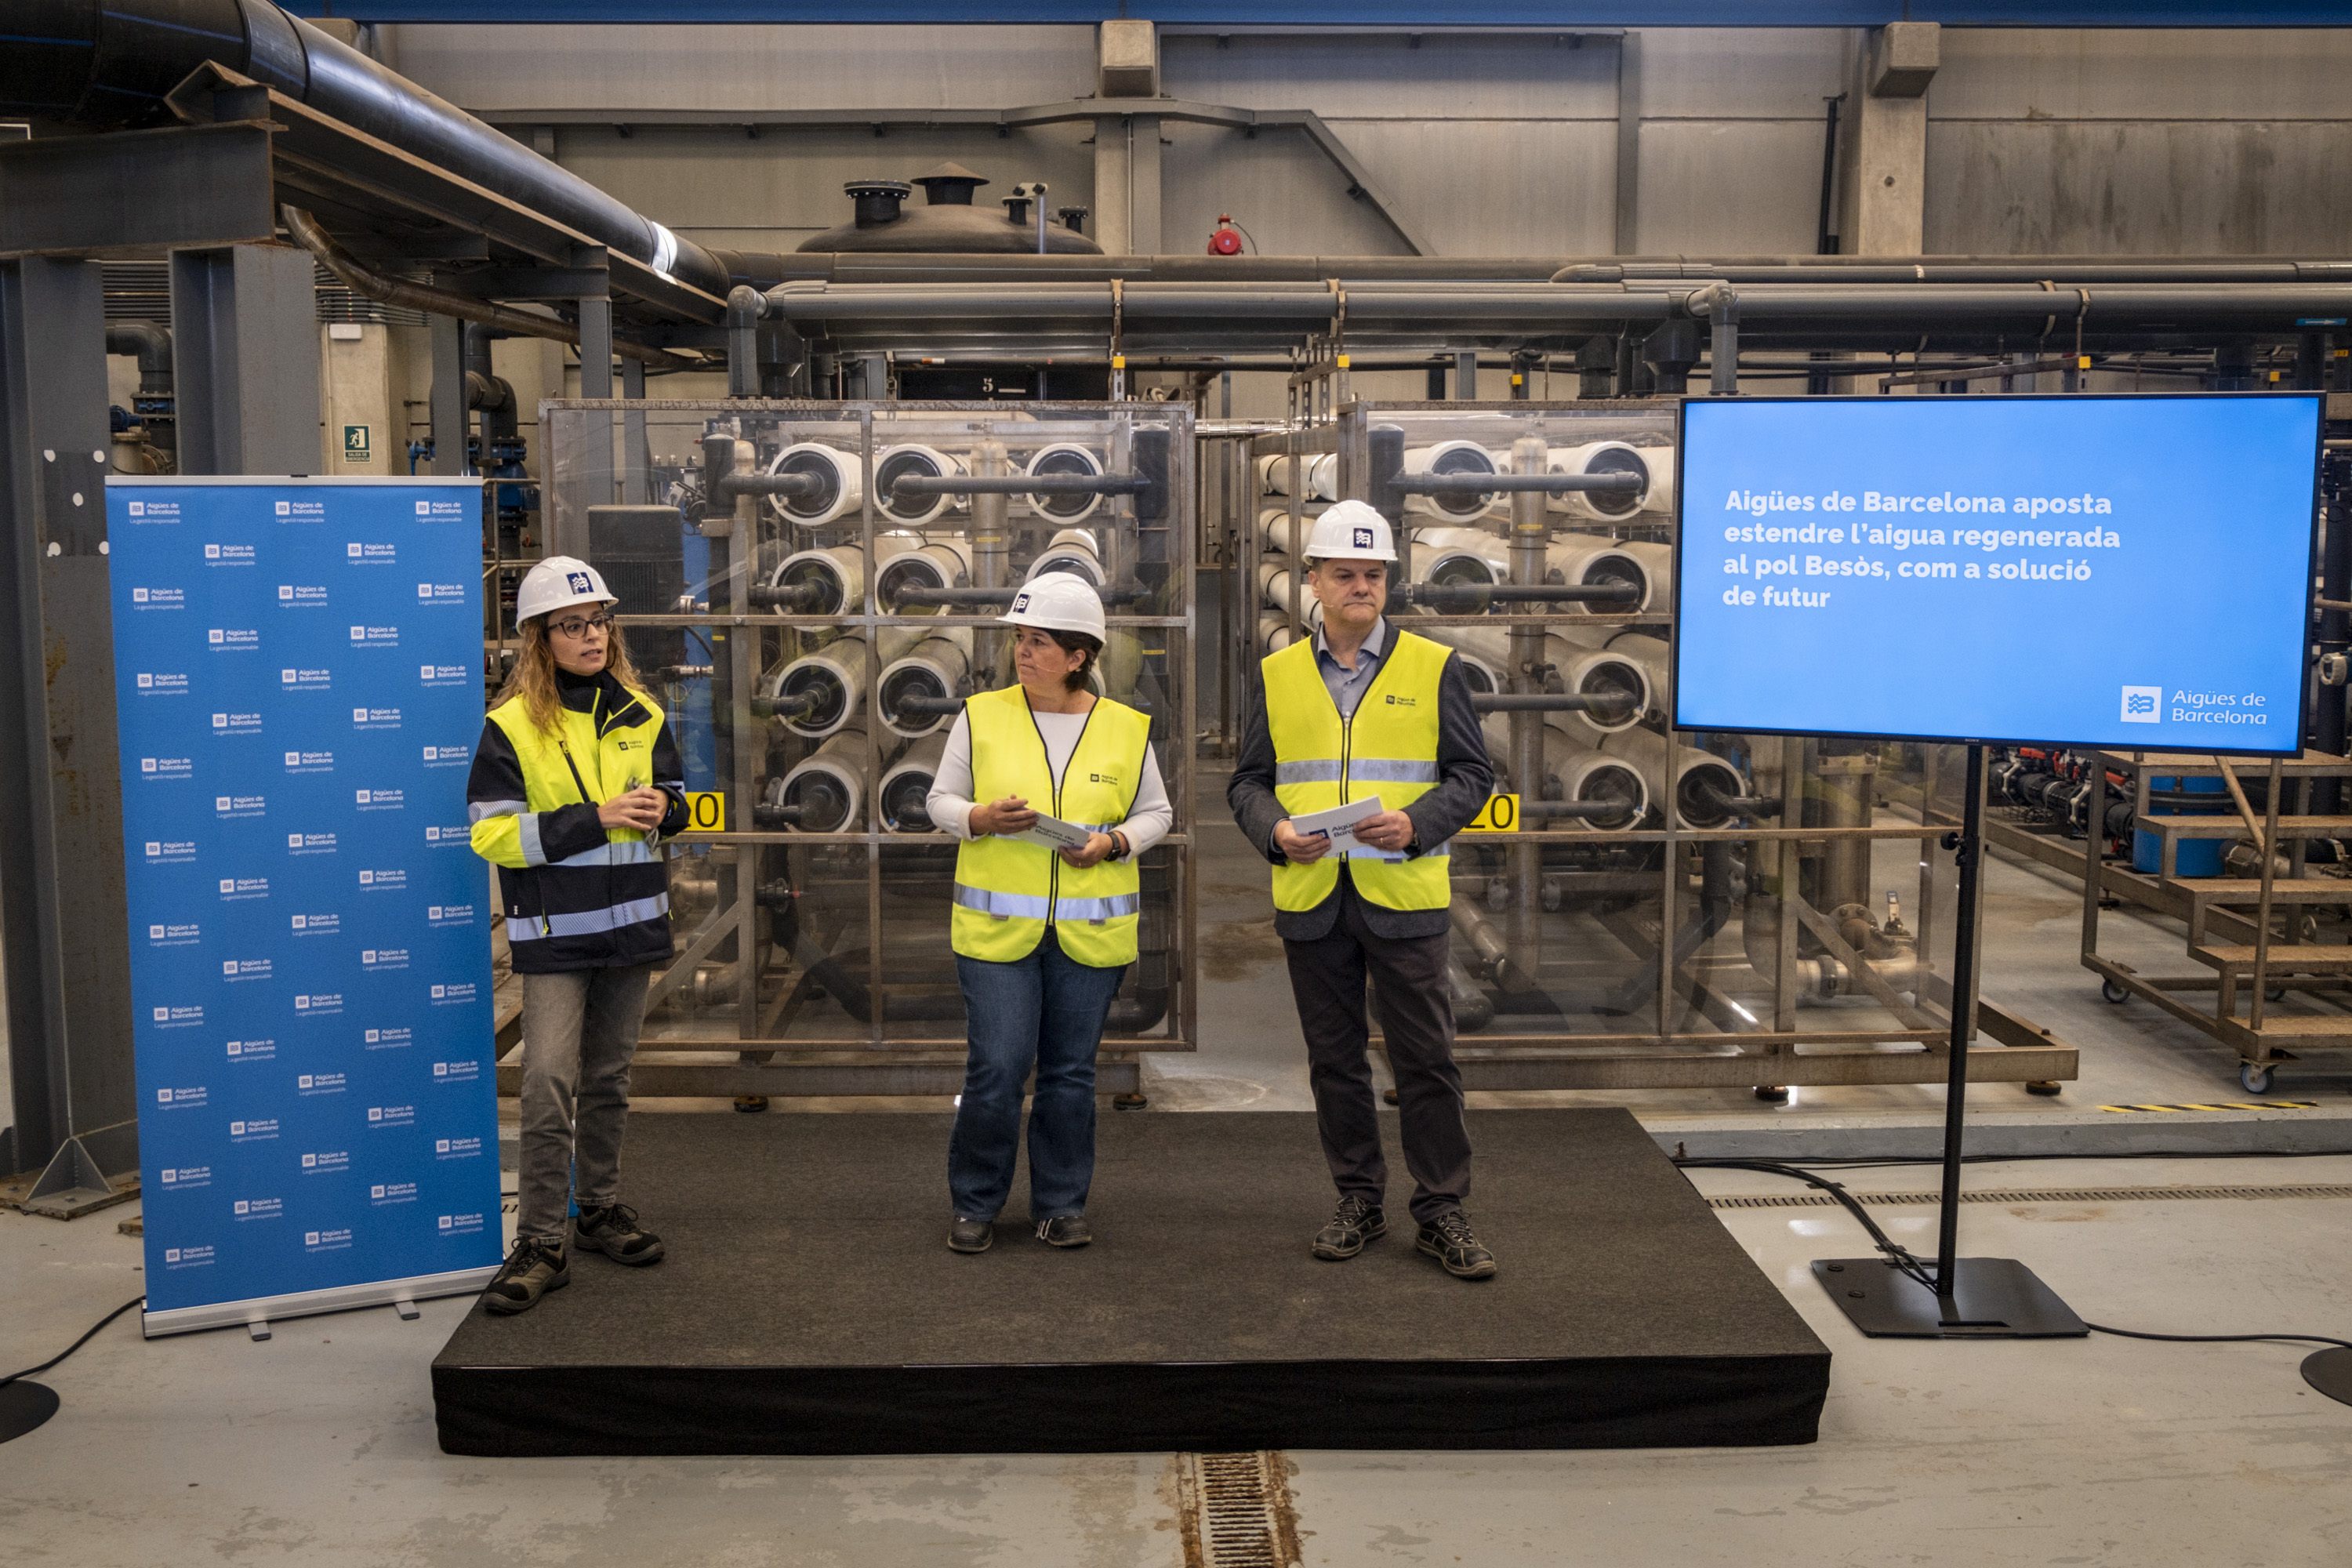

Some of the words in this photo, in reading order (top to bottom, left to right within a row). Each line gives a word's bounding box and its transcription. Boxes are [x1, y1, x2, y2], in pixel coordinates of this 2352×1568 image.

[982, 378, 994, 392] 5
[1725, 489, 1815, 517] Aigües
[1821, 490, 1857, 512] de
[1864, 491, 2005, 513] Barcelona
[2013, 493, 2111, 519] aposta
[1724, 523, 1845, 543] estendre
[1953, 526, 2120, 552] regenerada
[1723, 554, 1748, 575] al
[1755, 554, 1798, 579] pol
[1806, 555, 1890, 581] Besòs,
[1897, 561, 1957, 578] com
[1963, 562, 1980, 579] a
[1987, 558, 2092, 581] solució
[1722, 585, 1756, 606] de
[1762, 586, 1831, 608] futur
[2172, 690, 2236, 709] Aigües
[2241, 692, 2266, 706] de
[2172, 708, 2267, 724] Barcelona
[687, 793, 719, 828] 0
